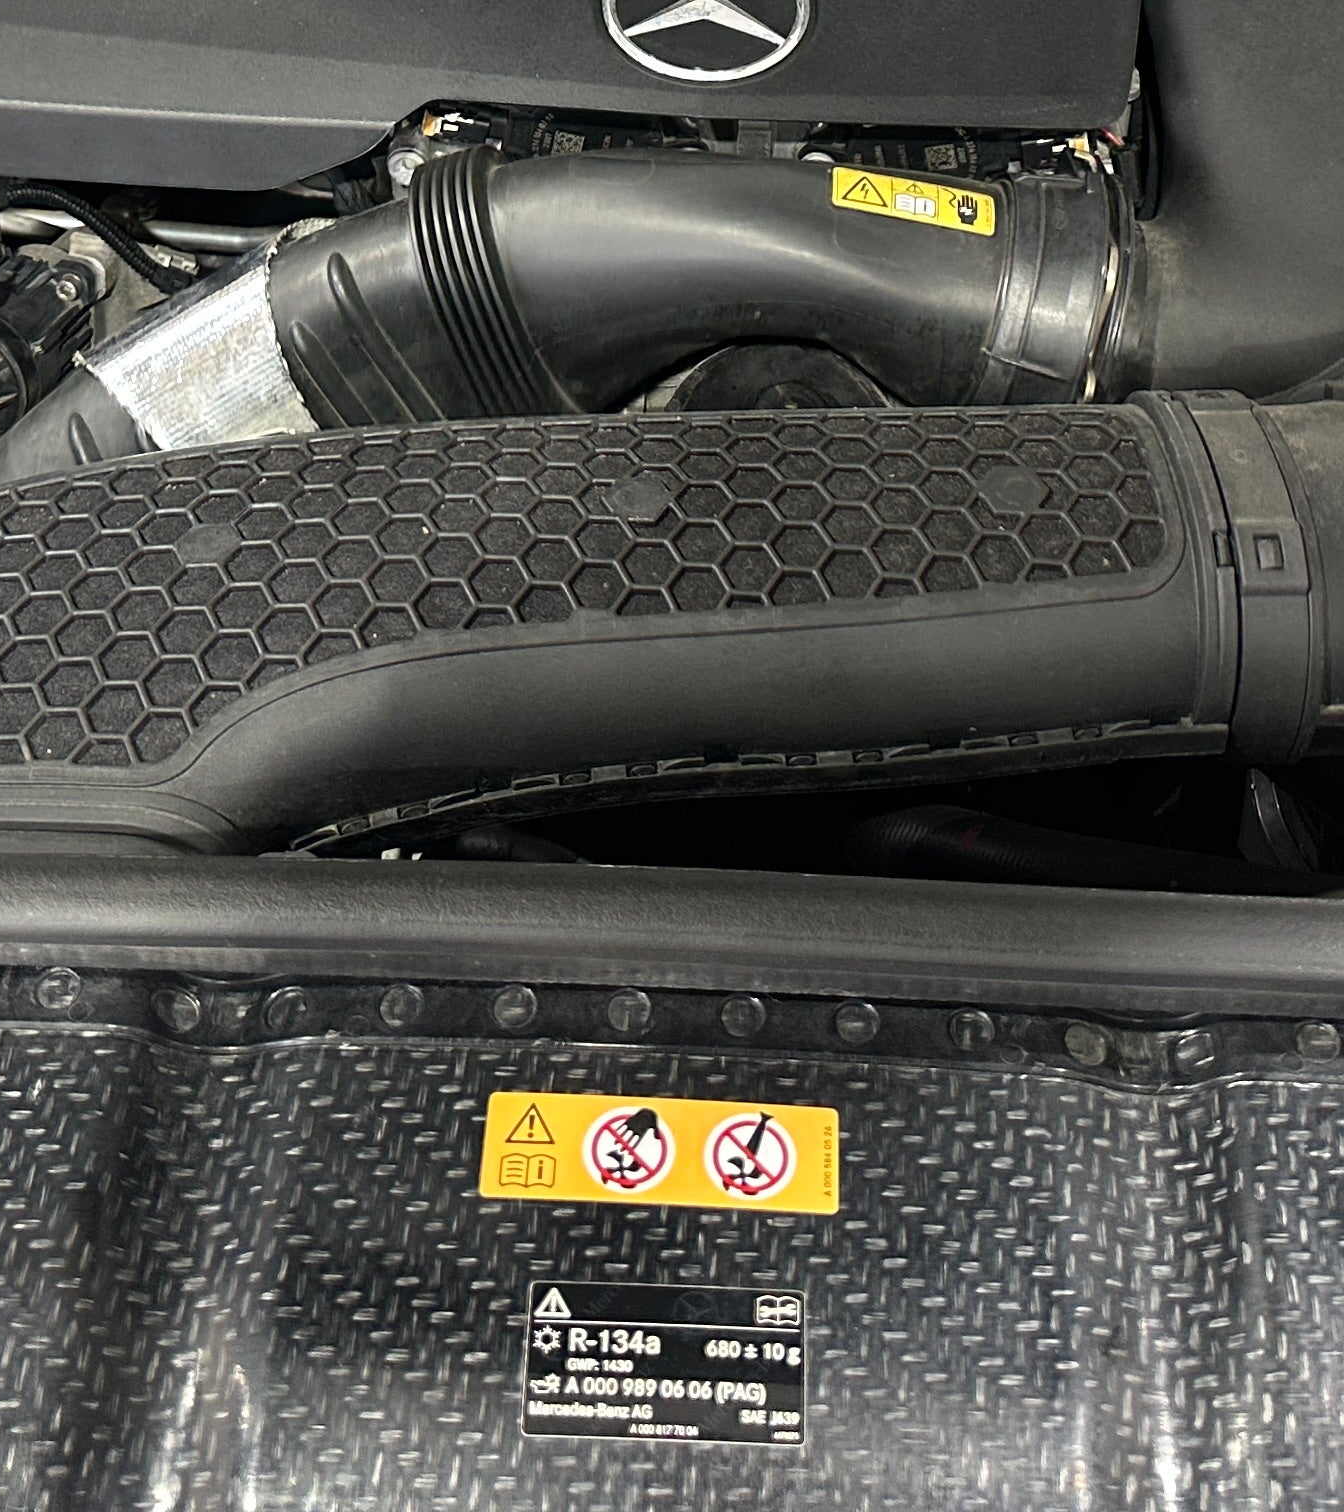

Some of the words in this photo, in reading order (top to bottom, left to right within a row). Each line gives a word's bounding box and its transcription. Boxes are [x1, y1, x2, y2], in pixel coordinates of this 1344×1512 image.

[864, 692, 967, 704] Mercedes-Benz
[970, 696, 989, 706] Oil
[877, 701, 972, 711] recommended
[568, 1327, 662, 1355] R-134a
[704, 1339, 742, 1359] 680
[763, 1342, 786, 1361] 10
[786, 1346, 801, 1366] g
[566, 1357, 600, 1372] GWP:
[602, 1359, 634, 1374] 1430
[563, 1375, 580, 1394] A
[582, 1376, 619, 1396] 000
[621, 1378, 657, 1397] 989
[659, 1379, 685, 1399] 06
[687, 1380, 713, 1400] 06
[715, 1381, 767, 1406] (PAG)
[528, 1400, 630, 1419] Mercedes-Benz
[631, 1403, 654, 1420] AG
[739, 1409, 767, 1425] SAE
[629, 1422, 638, 1434] A
